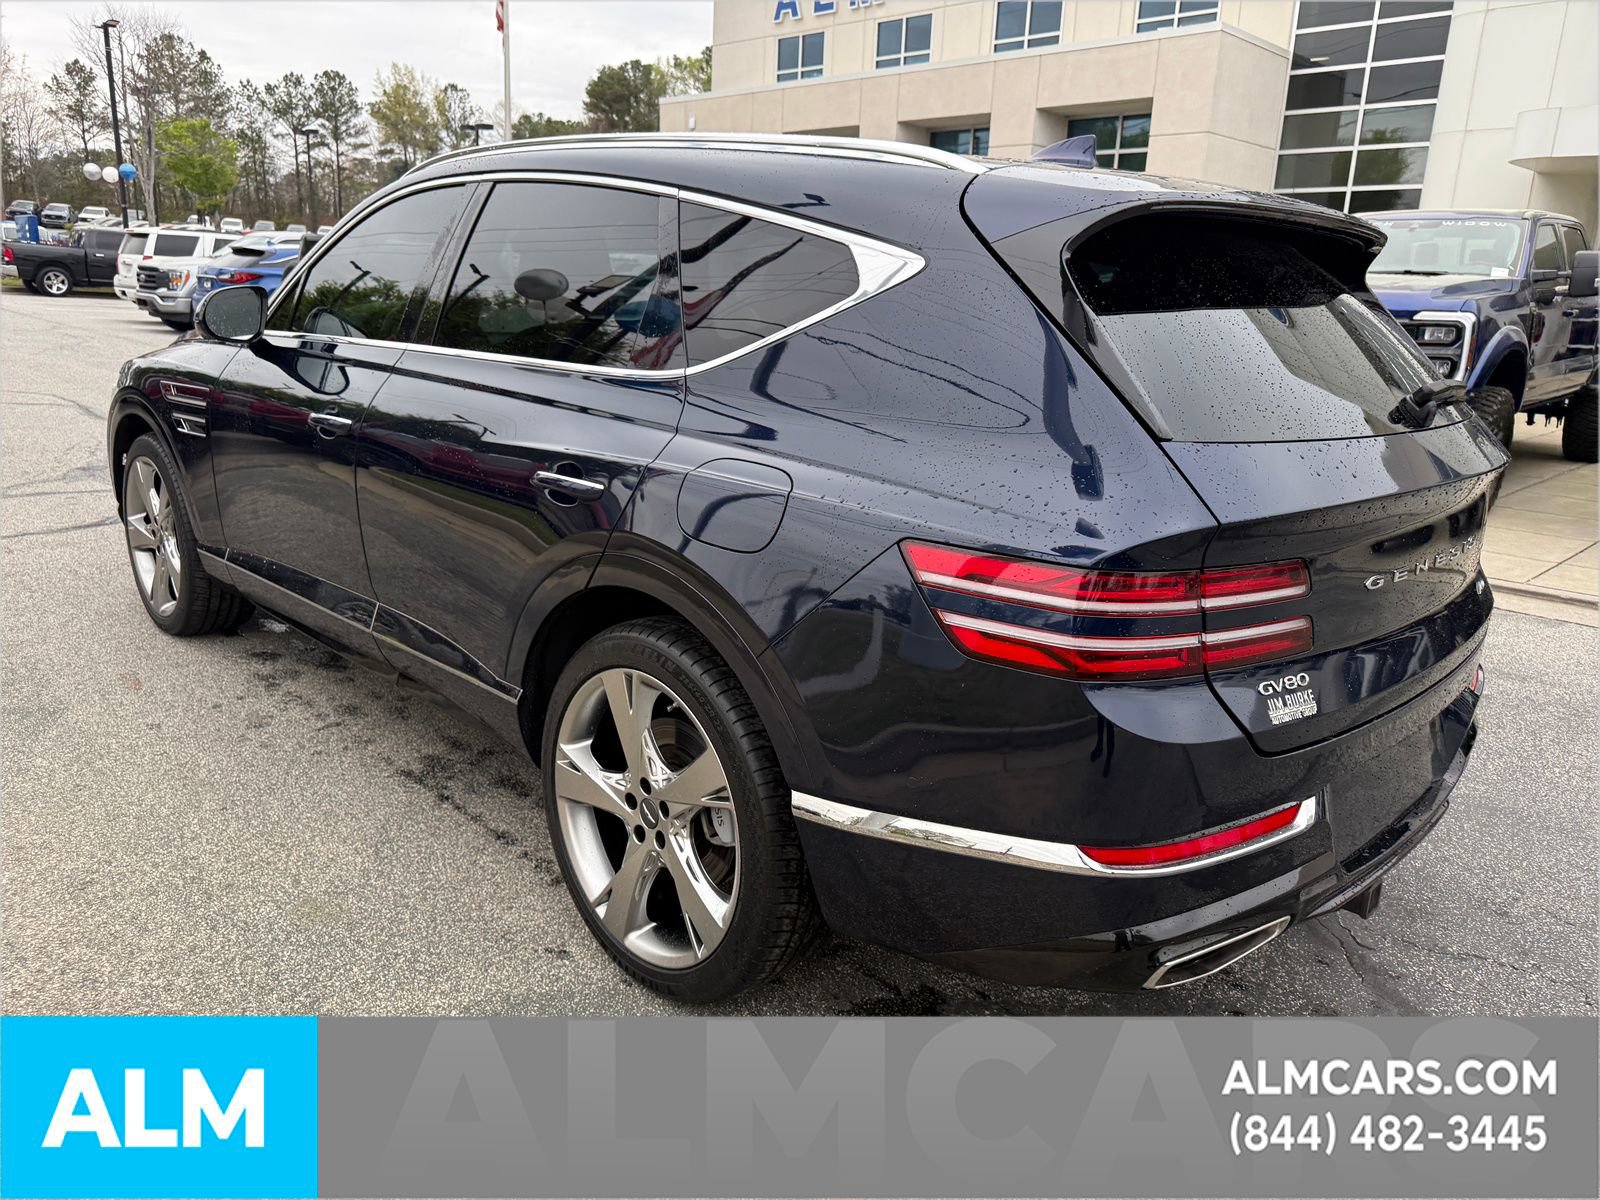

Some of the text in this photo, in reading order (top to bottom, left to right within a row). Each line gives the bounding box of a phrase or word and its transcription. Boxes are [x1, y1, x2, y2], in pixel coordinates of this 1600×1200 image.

[1363, 536, 1474, 591] GENESIS
[1257, 672, 1310, 696] GV80
[1267, 689, 1316, 714] JIM BURKE
